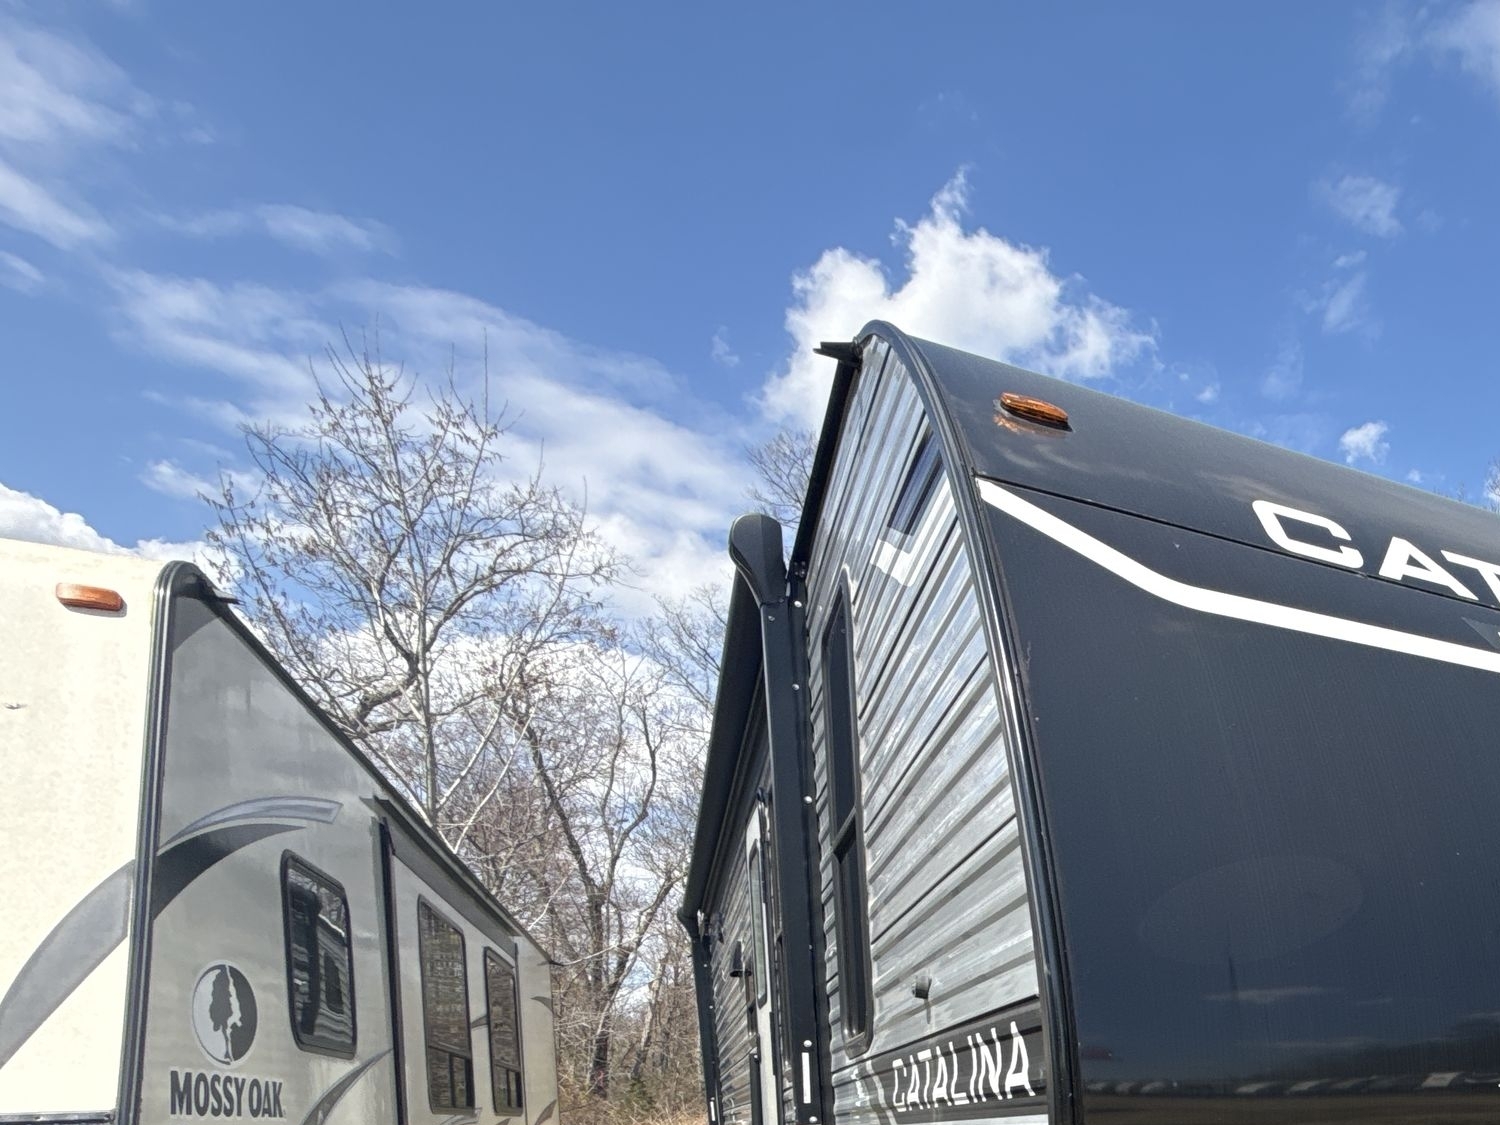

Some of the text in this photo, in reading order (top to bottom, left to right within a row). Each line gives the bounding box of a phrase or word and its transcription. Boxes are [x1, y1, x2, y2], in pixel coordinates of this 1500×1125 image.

[170, 1070, 283, 1118] MOSSY OAK
[892, 1021, 1036, 1112] CATALINA
